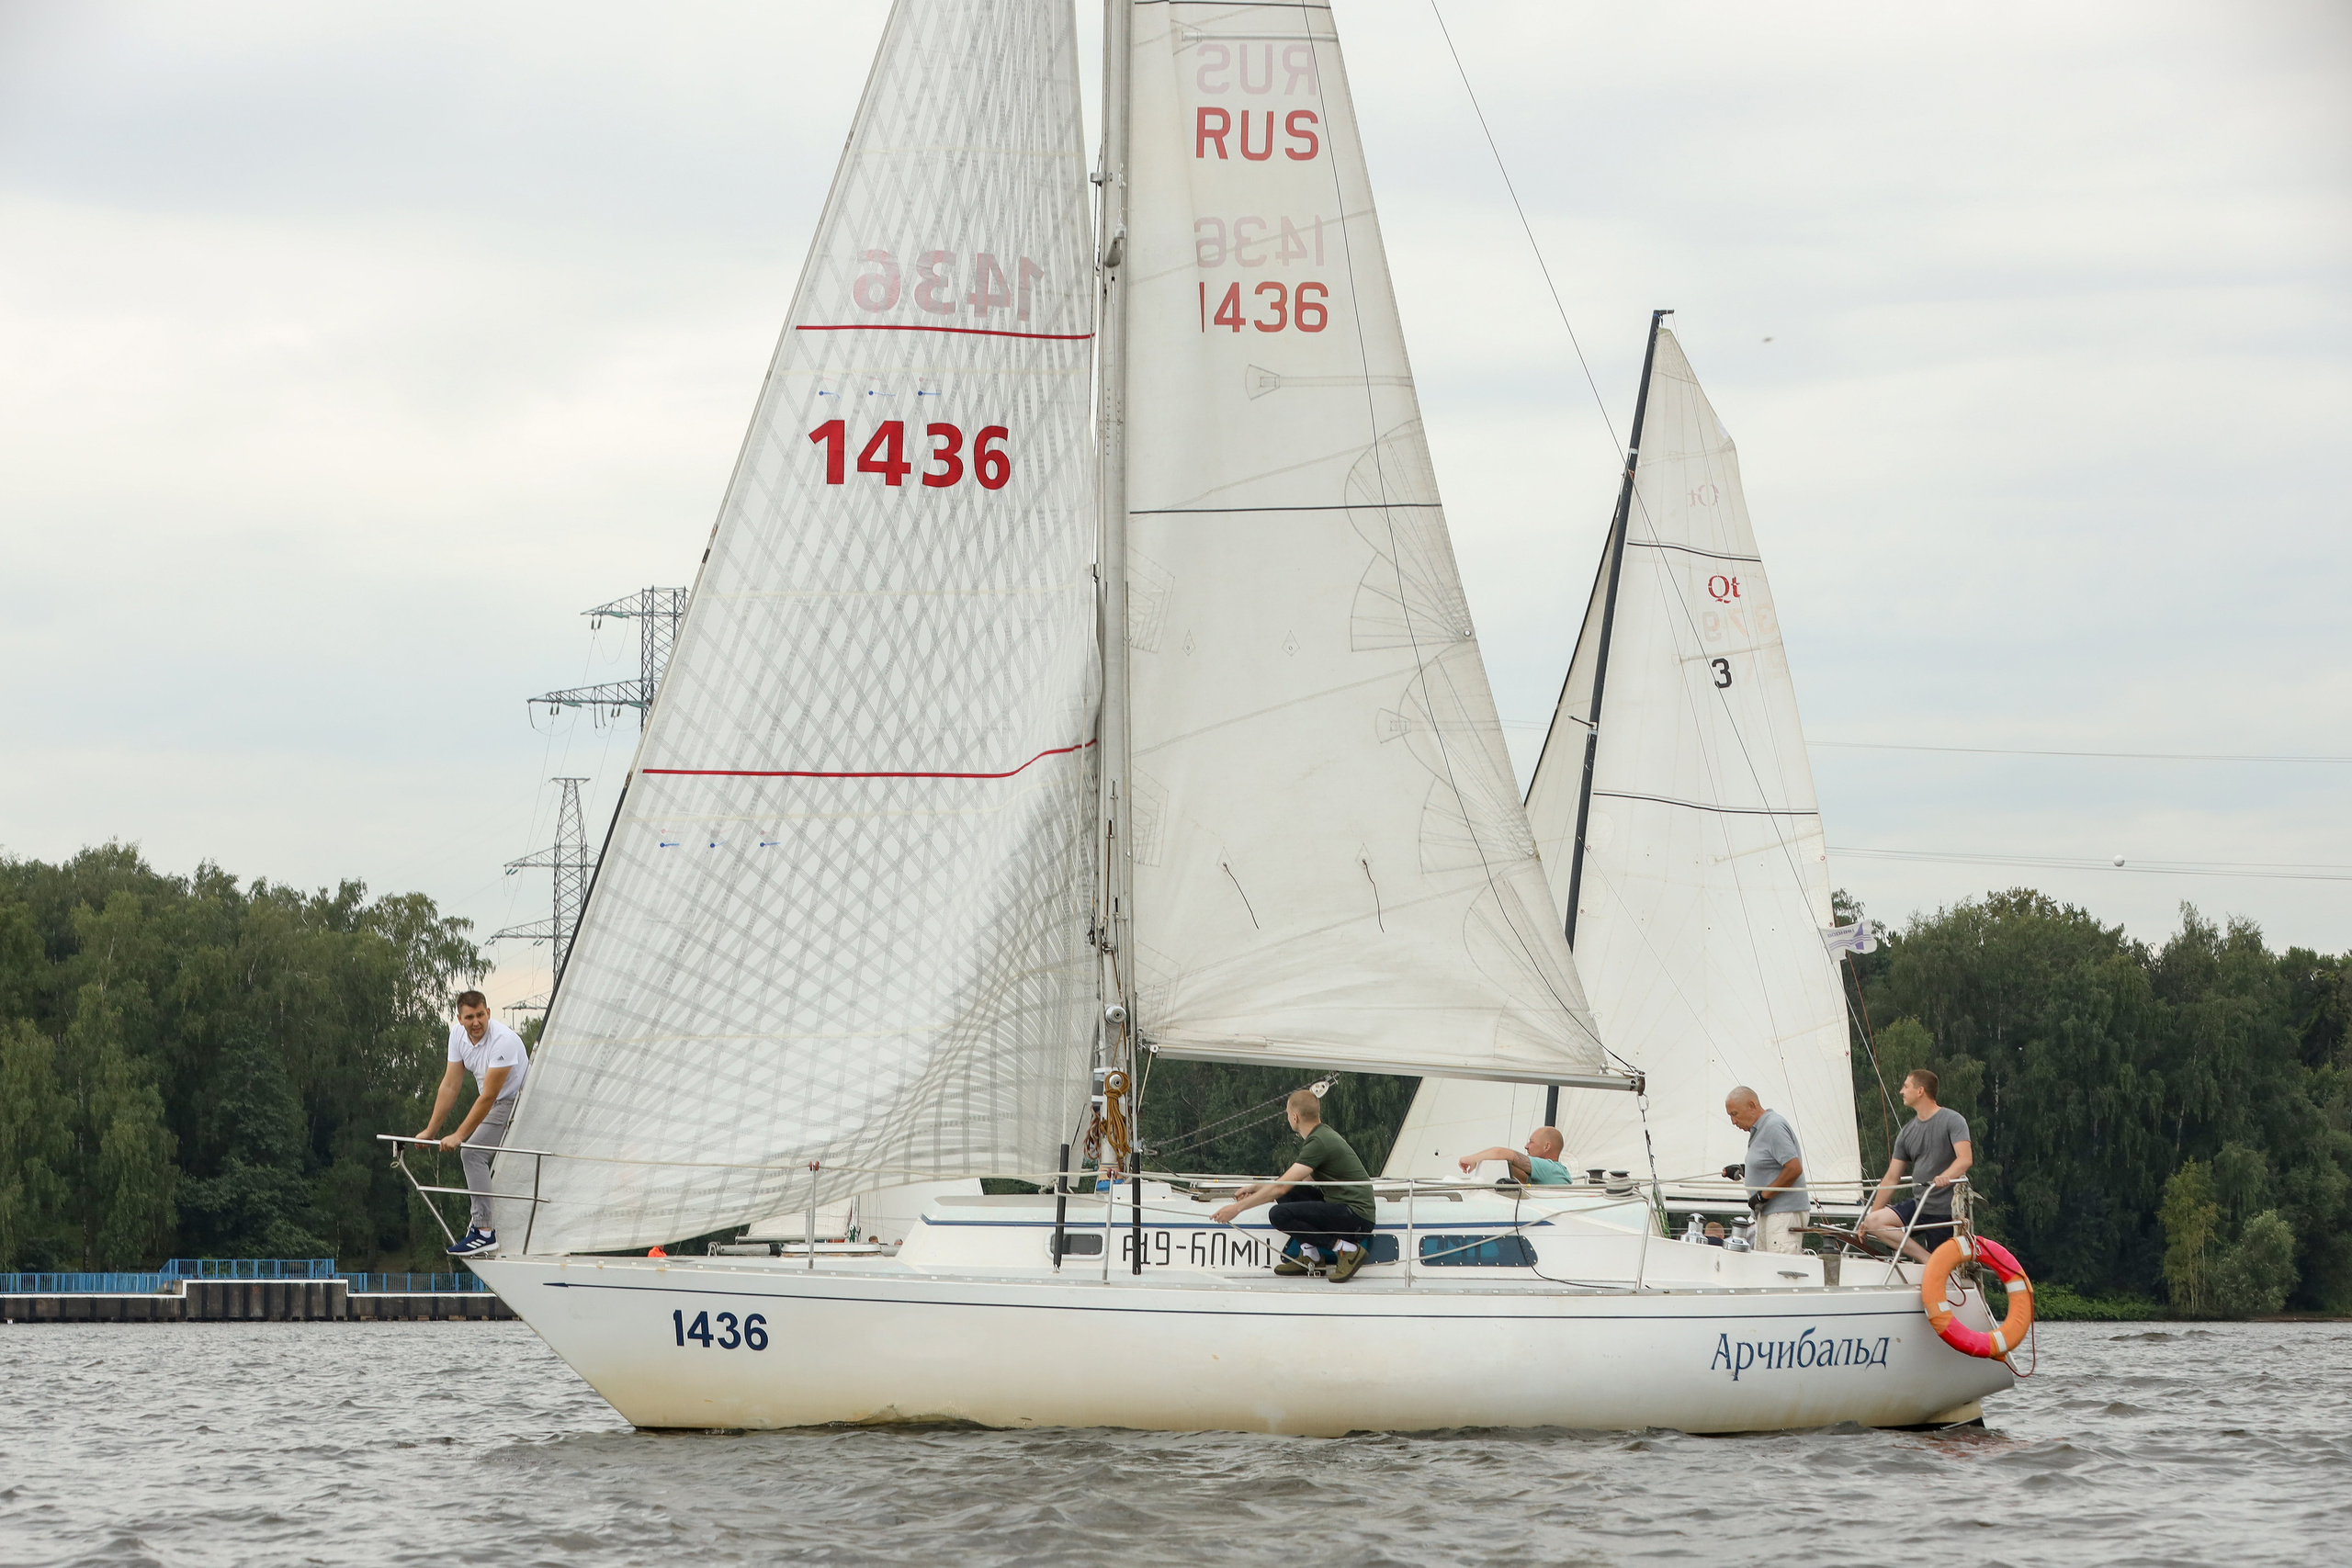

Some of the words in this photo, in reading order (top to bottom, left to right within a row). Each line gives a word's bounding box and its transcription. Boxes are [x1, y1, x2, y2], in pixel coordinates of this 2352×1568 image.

[1195, 107, 1319, 161] RUS
[1198, 281, 1329, 333] 1436
[808, 419, 1012, 491] 1436
[1707, 574, 1741, 604] Qt
[673, 1309, 769, 1351] 1436
[1710, 1325, 1891, 1382] Арчибальд
